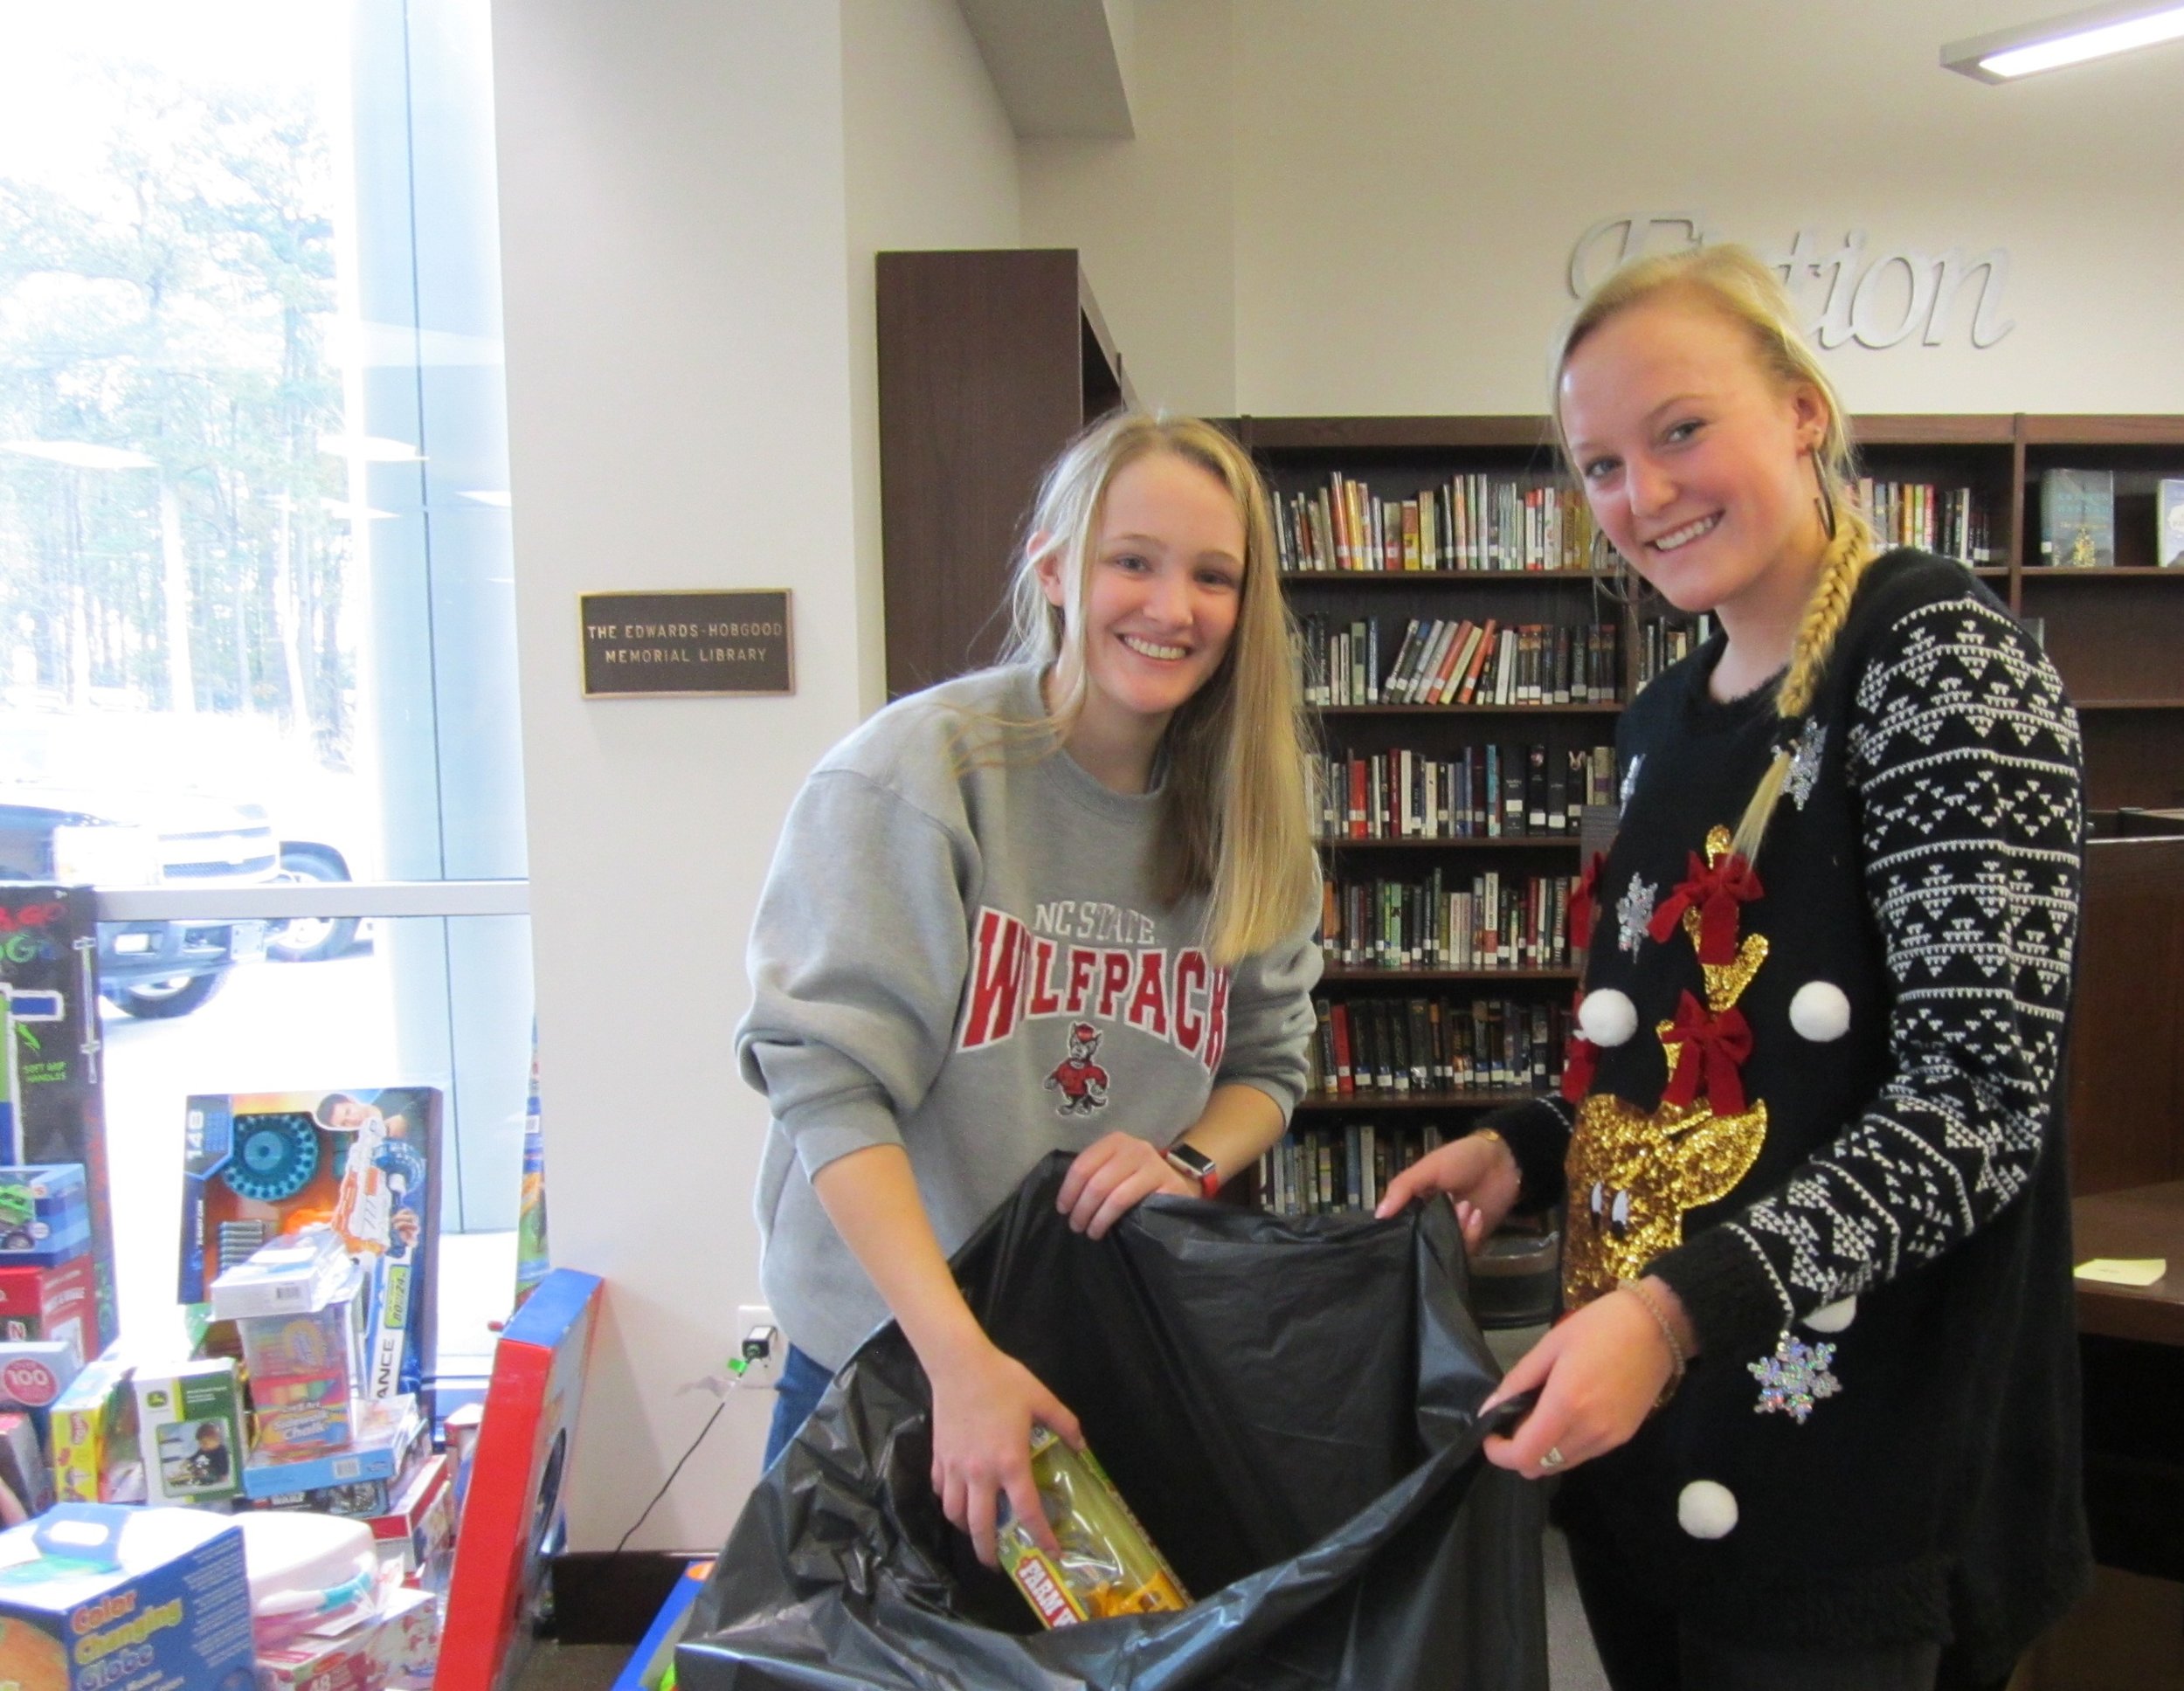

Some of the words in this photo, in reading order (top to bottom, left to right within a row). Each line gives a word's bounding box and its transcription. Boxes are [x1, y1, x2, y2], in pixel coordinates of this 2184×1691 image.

[1565, 204, 2015, 351] Ftion
[588, 625, 617, 639] THE
[605, 649, 690, 664] MEMORIAL
[700, 648, 767, 663] LIBRARY
[1033, 901, 1076, 935] NC
[1077, 901, 1156, 945] STATE
[187, 1110, 204, 1160] 148
[7, 1369, 49, 1387] 100
[1017, 1558, 1065, 1618] FARM
[72, 1590, 138, 1635] Color
